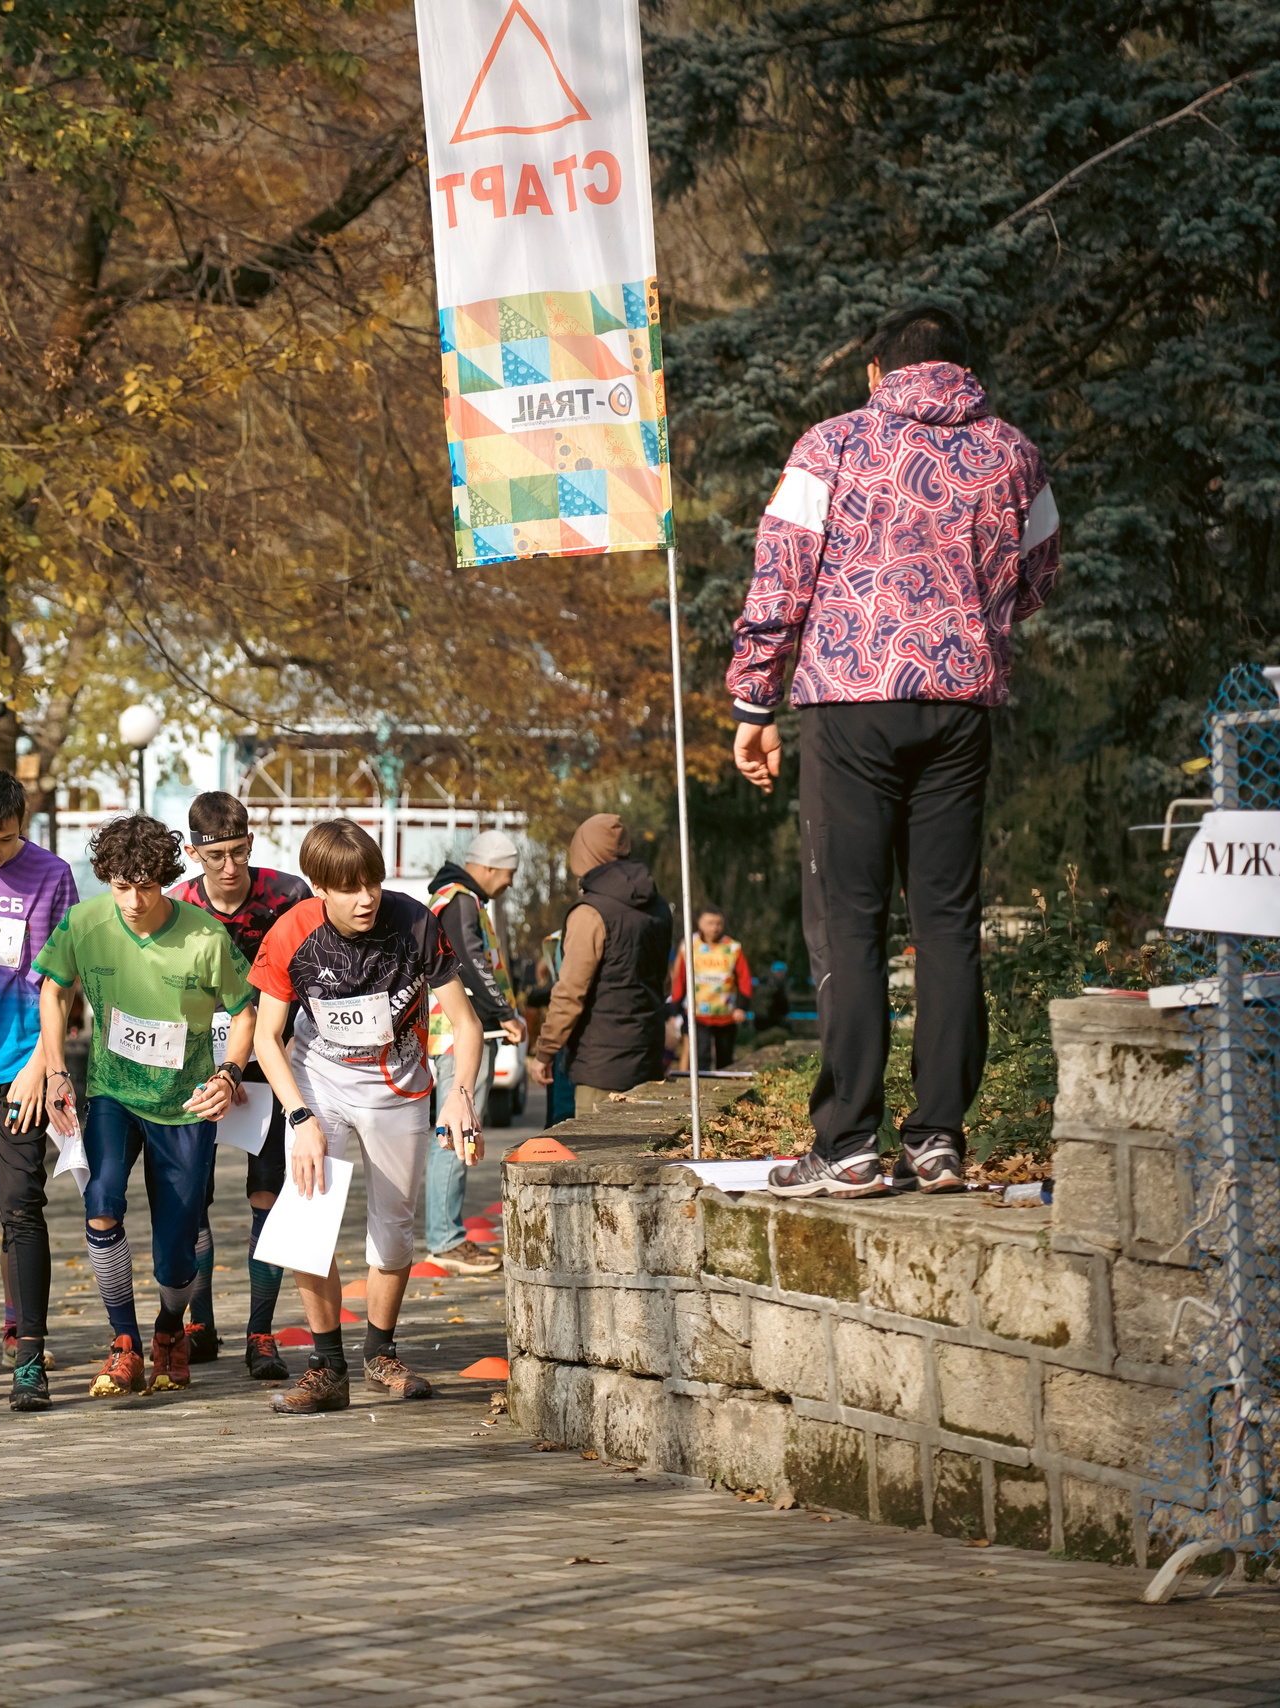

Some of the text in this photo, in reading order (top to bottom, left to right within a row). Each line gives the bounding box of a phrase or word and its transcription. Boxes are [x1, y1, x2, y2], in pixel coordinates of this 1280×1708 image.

[1198, 841, 1280, 877] МЖ
[328, 1010, 377, 1026] 260 1
[326, 1023, 350, 1032] МЖ16
[119, 1039, 141, 1052] МЖ16
[124, 1027, 170, 1051] 261 1
